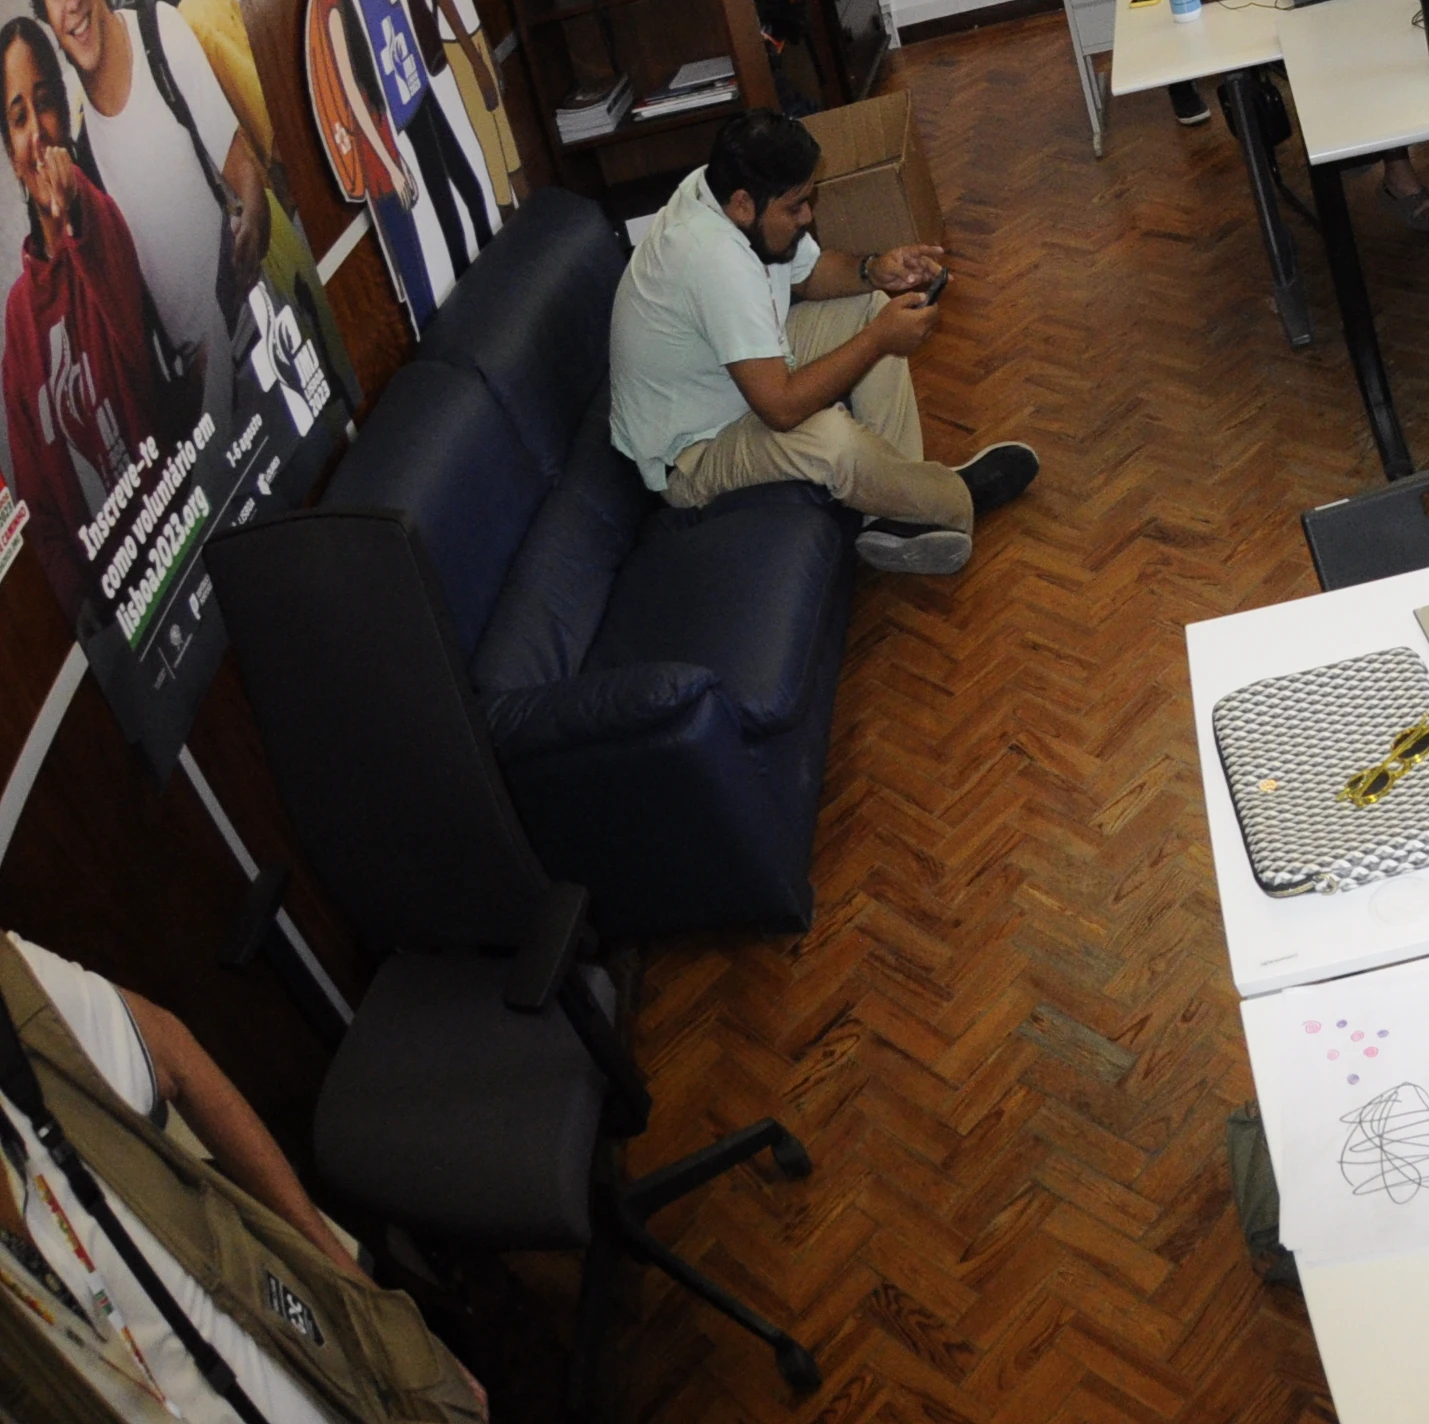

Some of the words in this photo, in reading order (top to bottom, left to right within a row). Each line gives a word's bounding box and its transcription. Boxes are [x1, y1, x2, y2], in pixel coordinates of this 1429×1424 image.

[226, 441, 242, 468] 1-6
[239, 413, 263, 452] agosto
[309, 379, 331, 417] 2023
[78, 435, 160, 562] Inscreve-te
[101, 534, 138, 600] como
[132, 440, 197, 545] voluntário
[193, 412, 216, 450] em
[115, 485, 210, 641] lisboa2023.org
